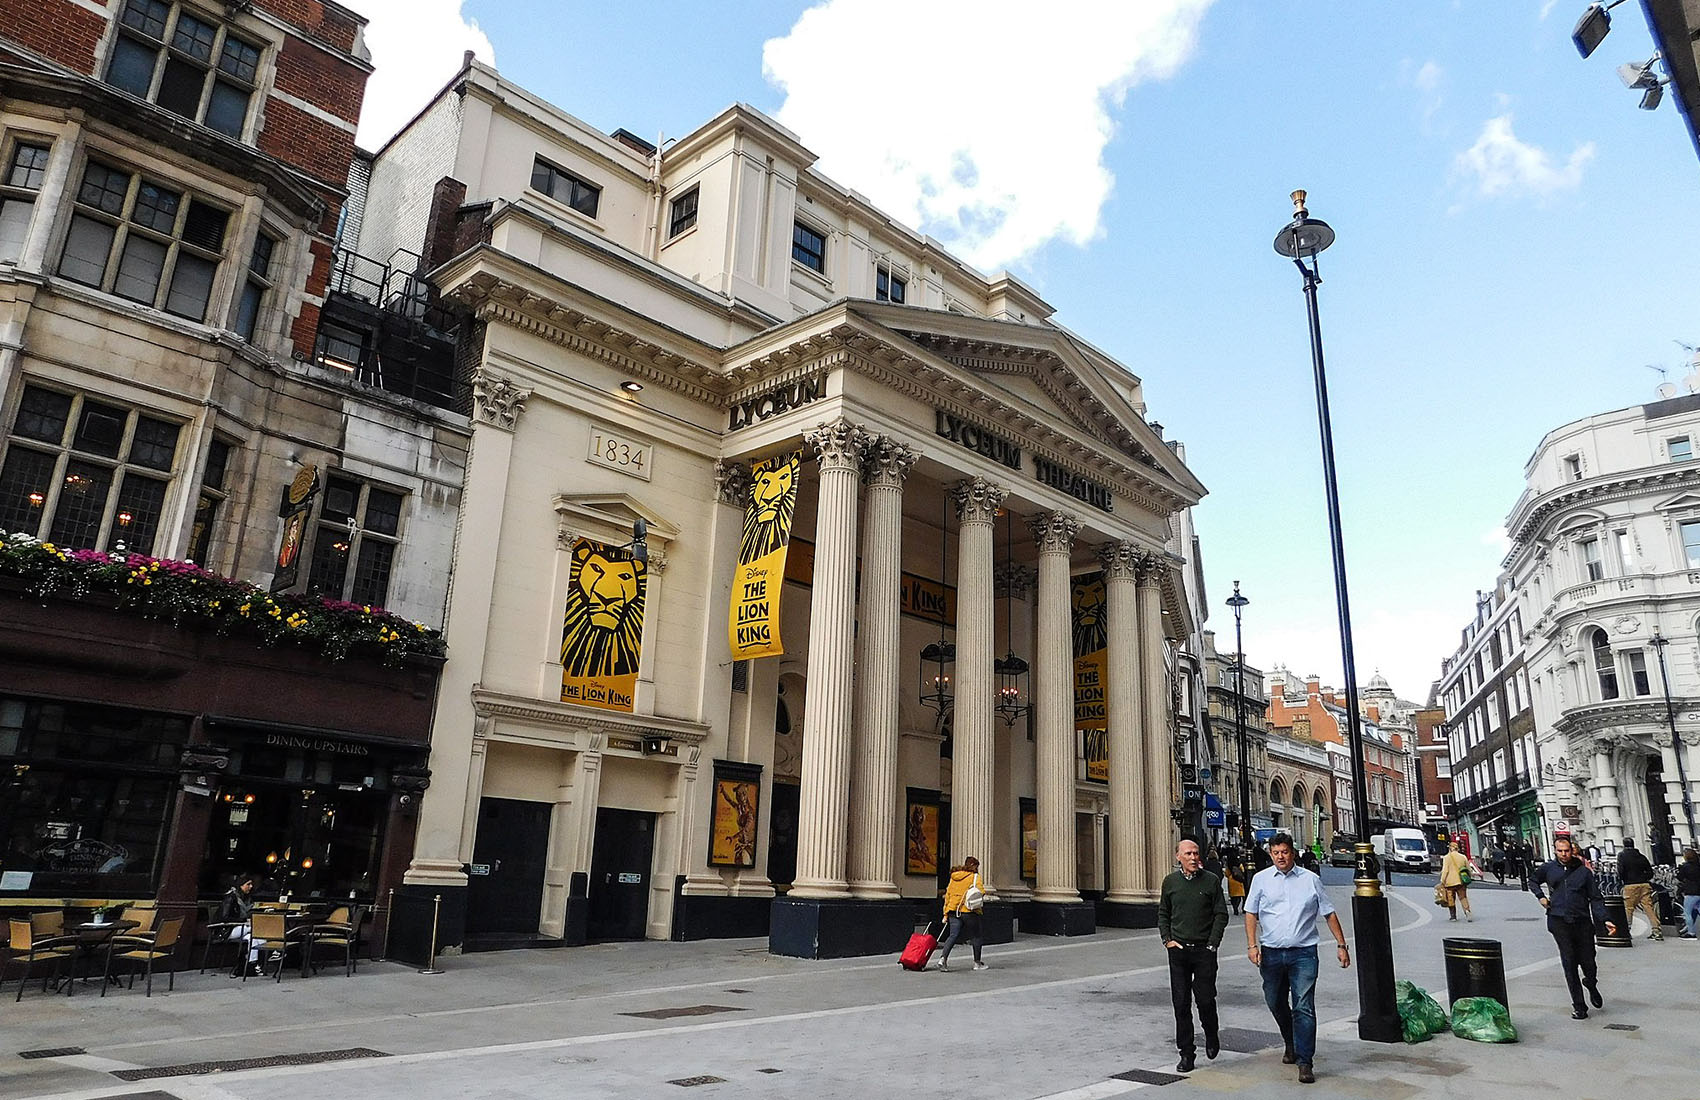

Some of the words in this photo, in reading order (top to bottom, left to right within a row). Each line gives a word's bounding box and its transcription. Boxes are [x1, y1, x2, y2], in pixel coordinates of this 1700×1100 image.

[728, 368, 827, 430] LYCEUM
[593, 436, 644, 470] 1834
[936, 410, 1023, 471] LYCEUM
[1033, 455, 1114, 513] THEATRE
[745, 567, 768, 579] Disney
[744, 580, 766, 598] THE
[912, 581, 946, 614] KING
[738, 602, 769, 621] LION
[737, 625, 770, 644] KING
[1078, 671, 1099, 684] THE
[562, 684, 580, 696] THE
[1075, 688, 1104, 701] LION
[1074, 704, 1105, 718] KING
[267, 734, 311, 749] DINING
[314, 740, 369, 756] UPSTAIRS
